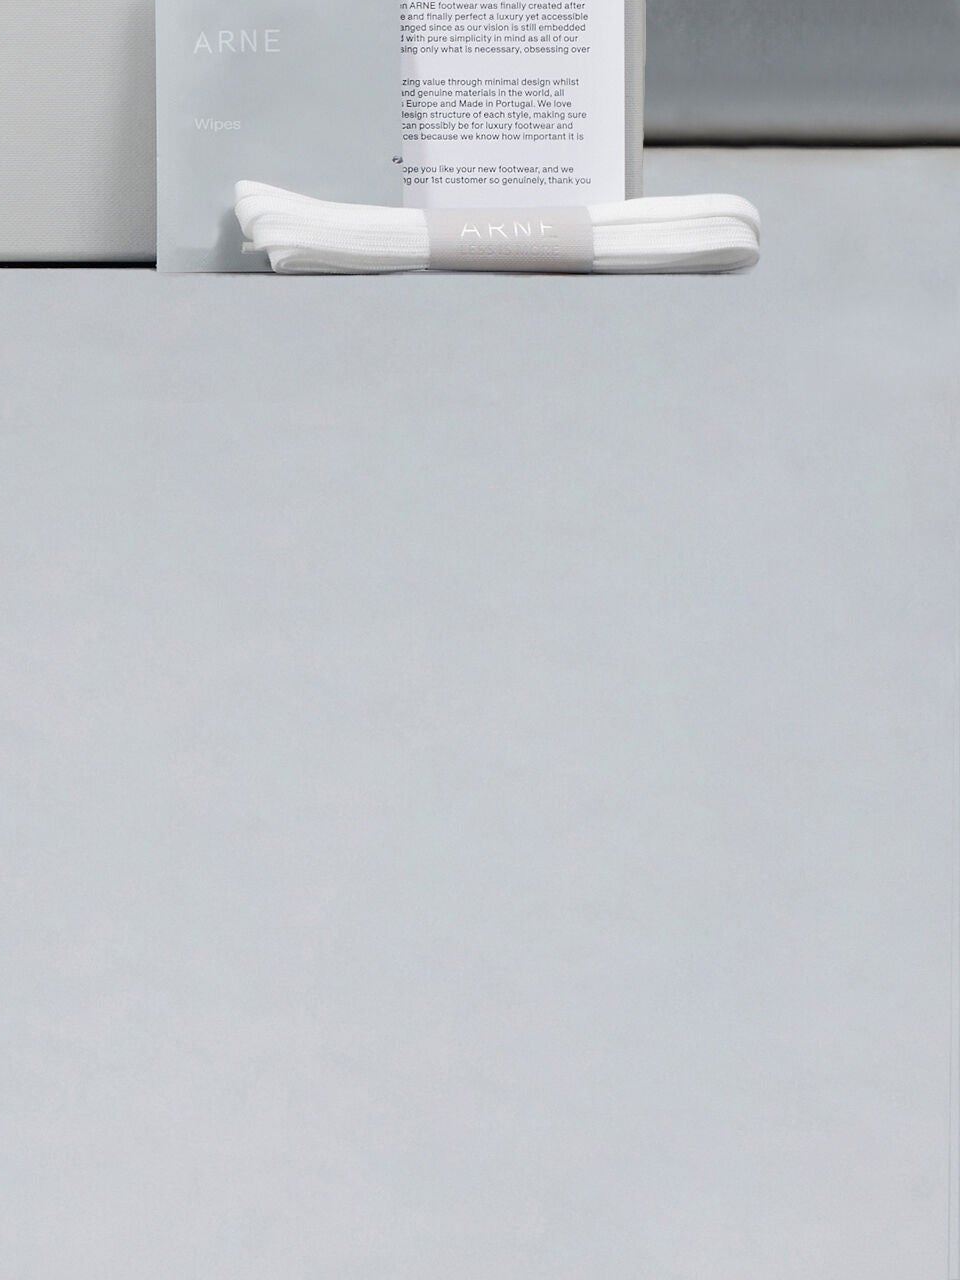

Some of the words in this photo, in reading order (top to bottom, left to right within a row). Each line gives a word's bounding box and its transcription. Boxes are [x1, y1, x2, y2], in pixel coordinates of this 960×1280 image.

[409, 1, 436, 10] ARNE
[438, 1, 478, 10] footwear
[500, 1, 527, 12] finally
[528, 1, 563, 10] created
[564, 1, 586, 10] after
[193, 29, 281, 54] ARNE
[406, 99, 439, 110] Europe
[439, 99, 457, 108] and
[458, 99, 484, 108] Made
[485, 99, 494, 108] in
[495, 99, 536, 110] Portugal.
[536, 99, 552, 108] We
[553, 99, 572, 108] love
[194, 118, 241, 132] Wipes
[420, 166, 437, 175] you
[439, 164, 455, 173] like
[455, 166, 476, 175] your
[498, 164, 541, 174] footwear,
[542, 164, 559, 173] and
[431, 175, 443, 184] 1st
[444, 175, 488, 184] customer
[501, 175, 547, 186] genuinely,
[547, 175, 574, 184] thank
[574, 177, 592, 186] you
